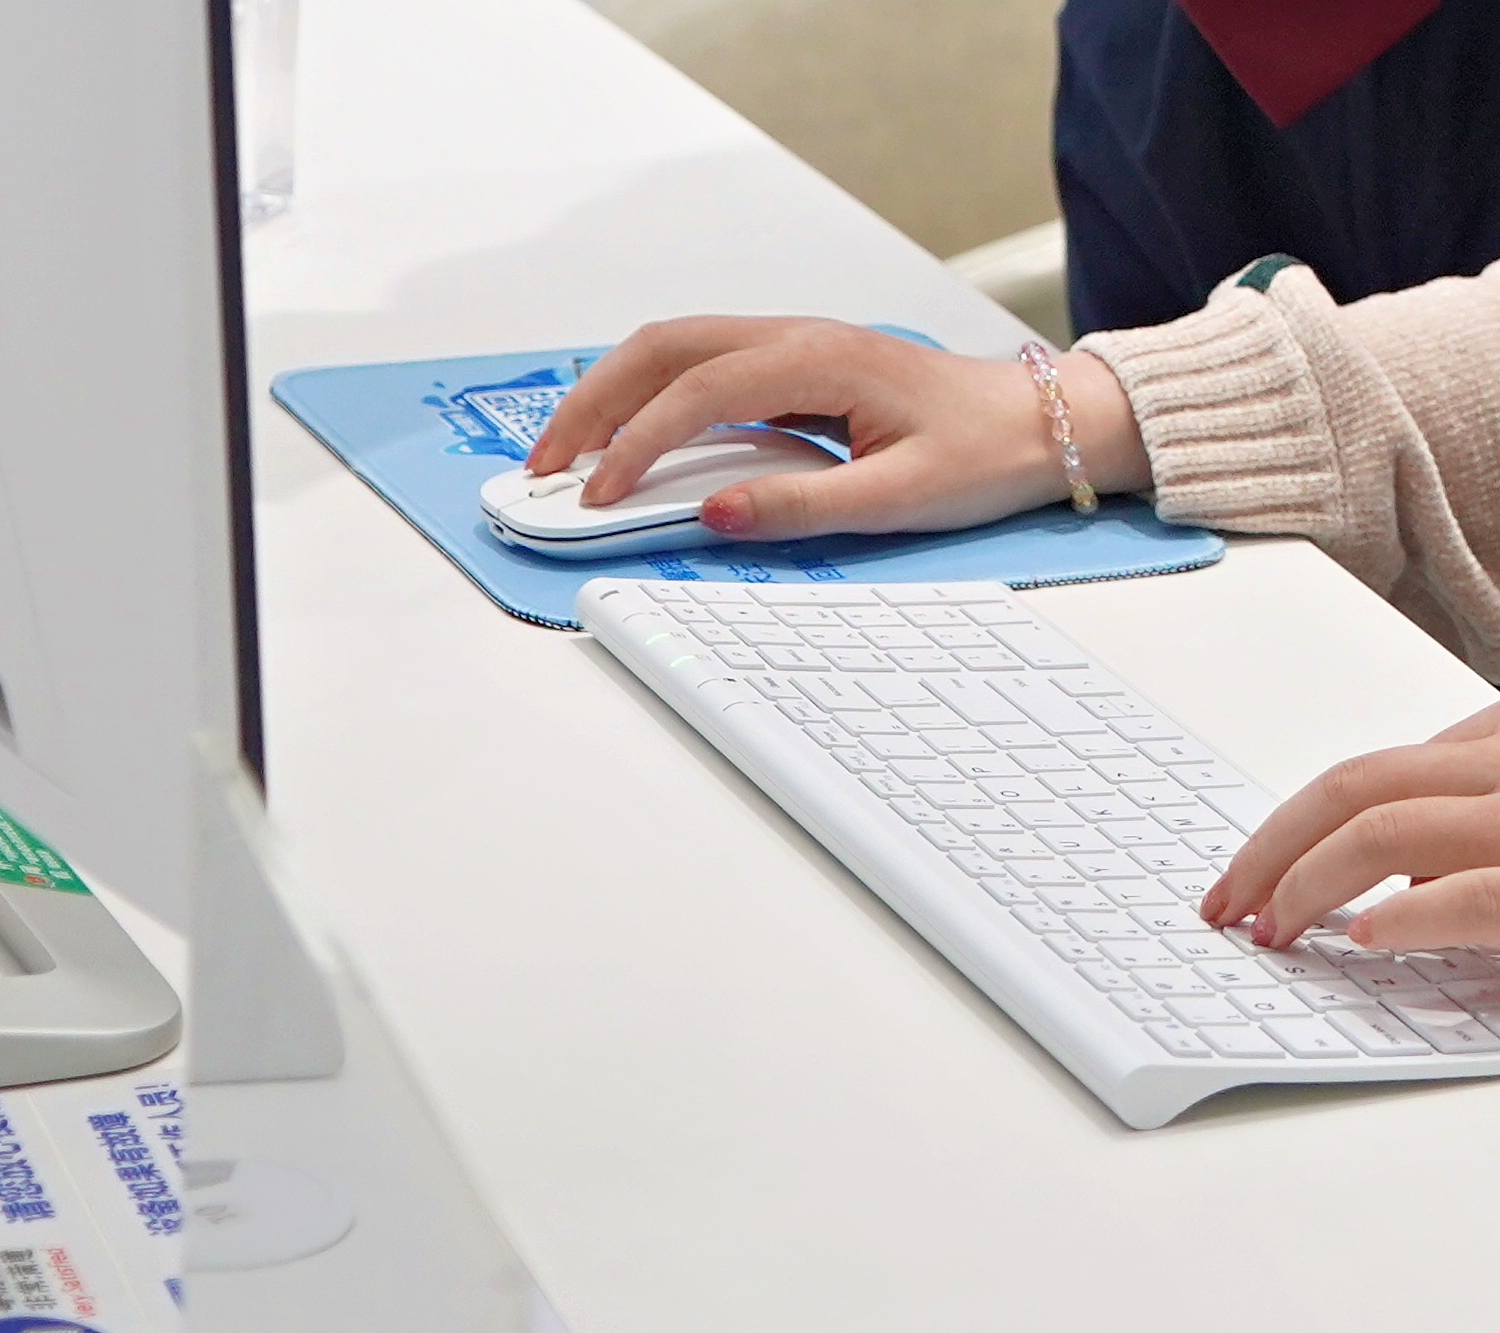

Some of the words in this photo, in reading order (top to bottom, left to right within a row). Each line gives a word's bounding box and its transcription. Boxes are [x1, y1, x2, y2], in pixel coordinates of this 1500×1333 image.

[86, 1110, 184, 1237] 设备如果有故障
